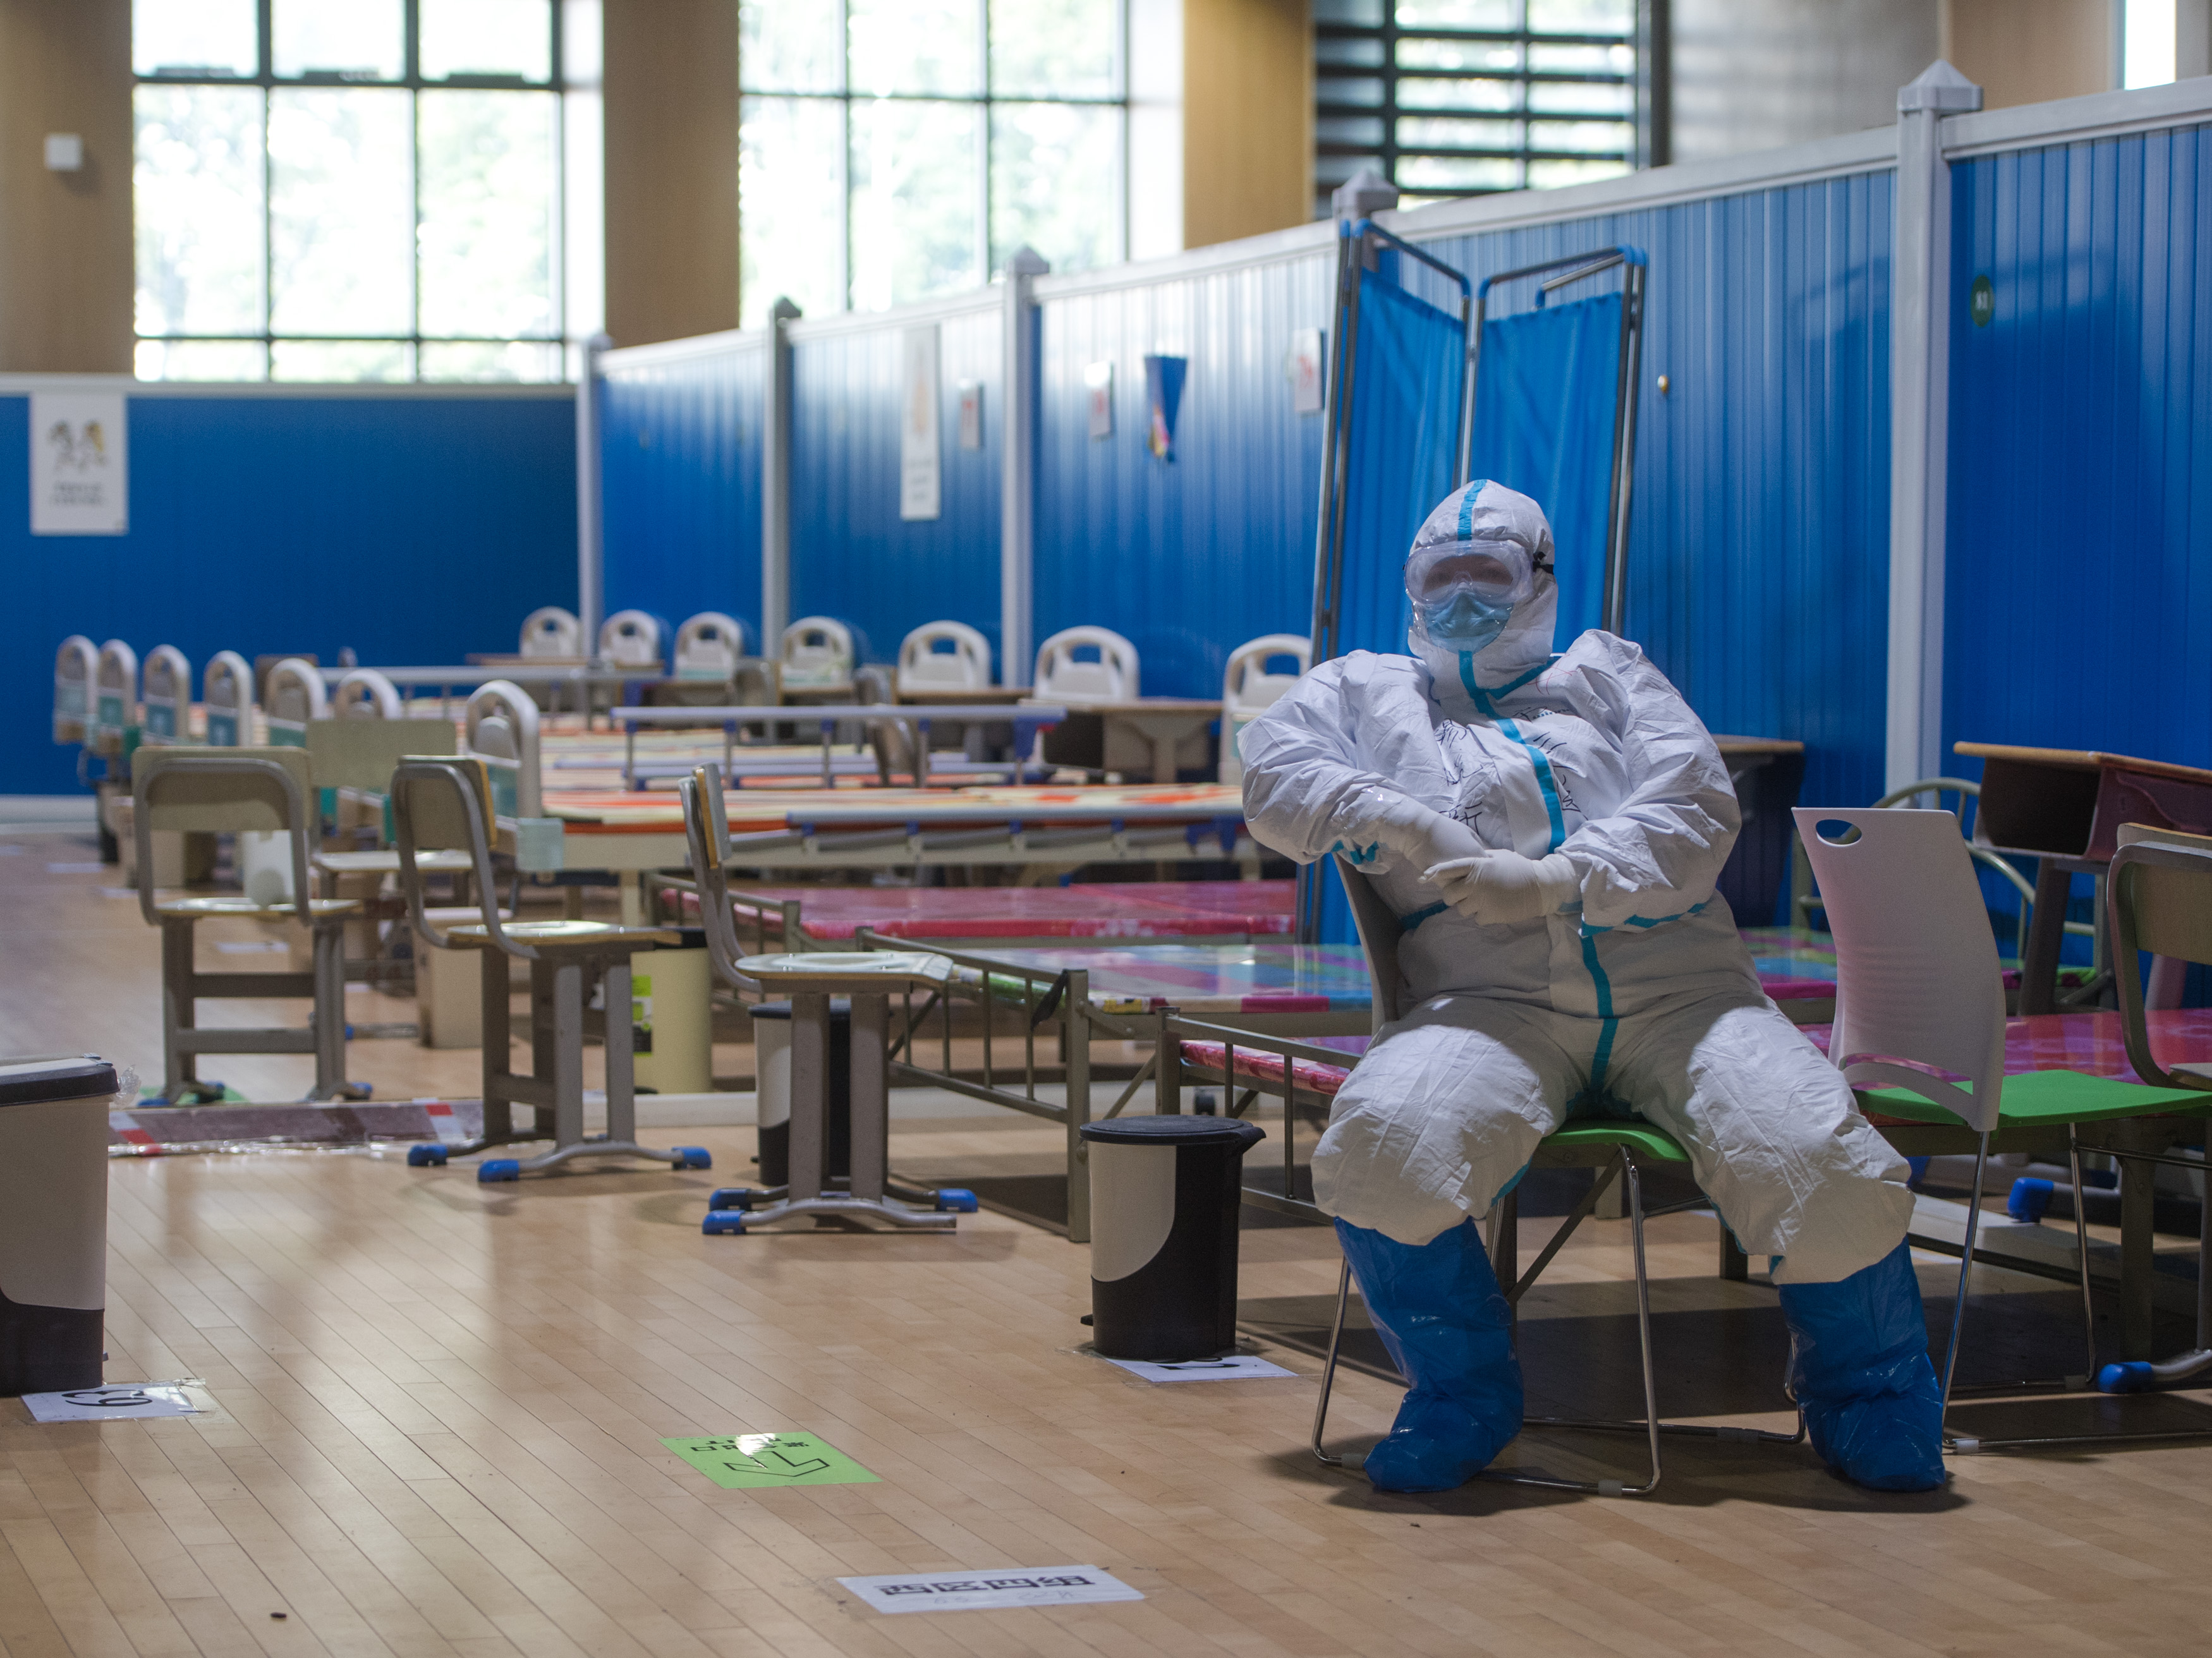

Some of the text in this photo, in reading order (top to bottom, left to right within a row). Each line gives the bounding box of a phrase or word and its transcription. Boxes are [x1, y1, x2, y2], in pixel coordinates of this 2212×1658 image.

[61, 1389, 153, 1407] 63
[873, 1575, 1096, 1595] 西区四组
